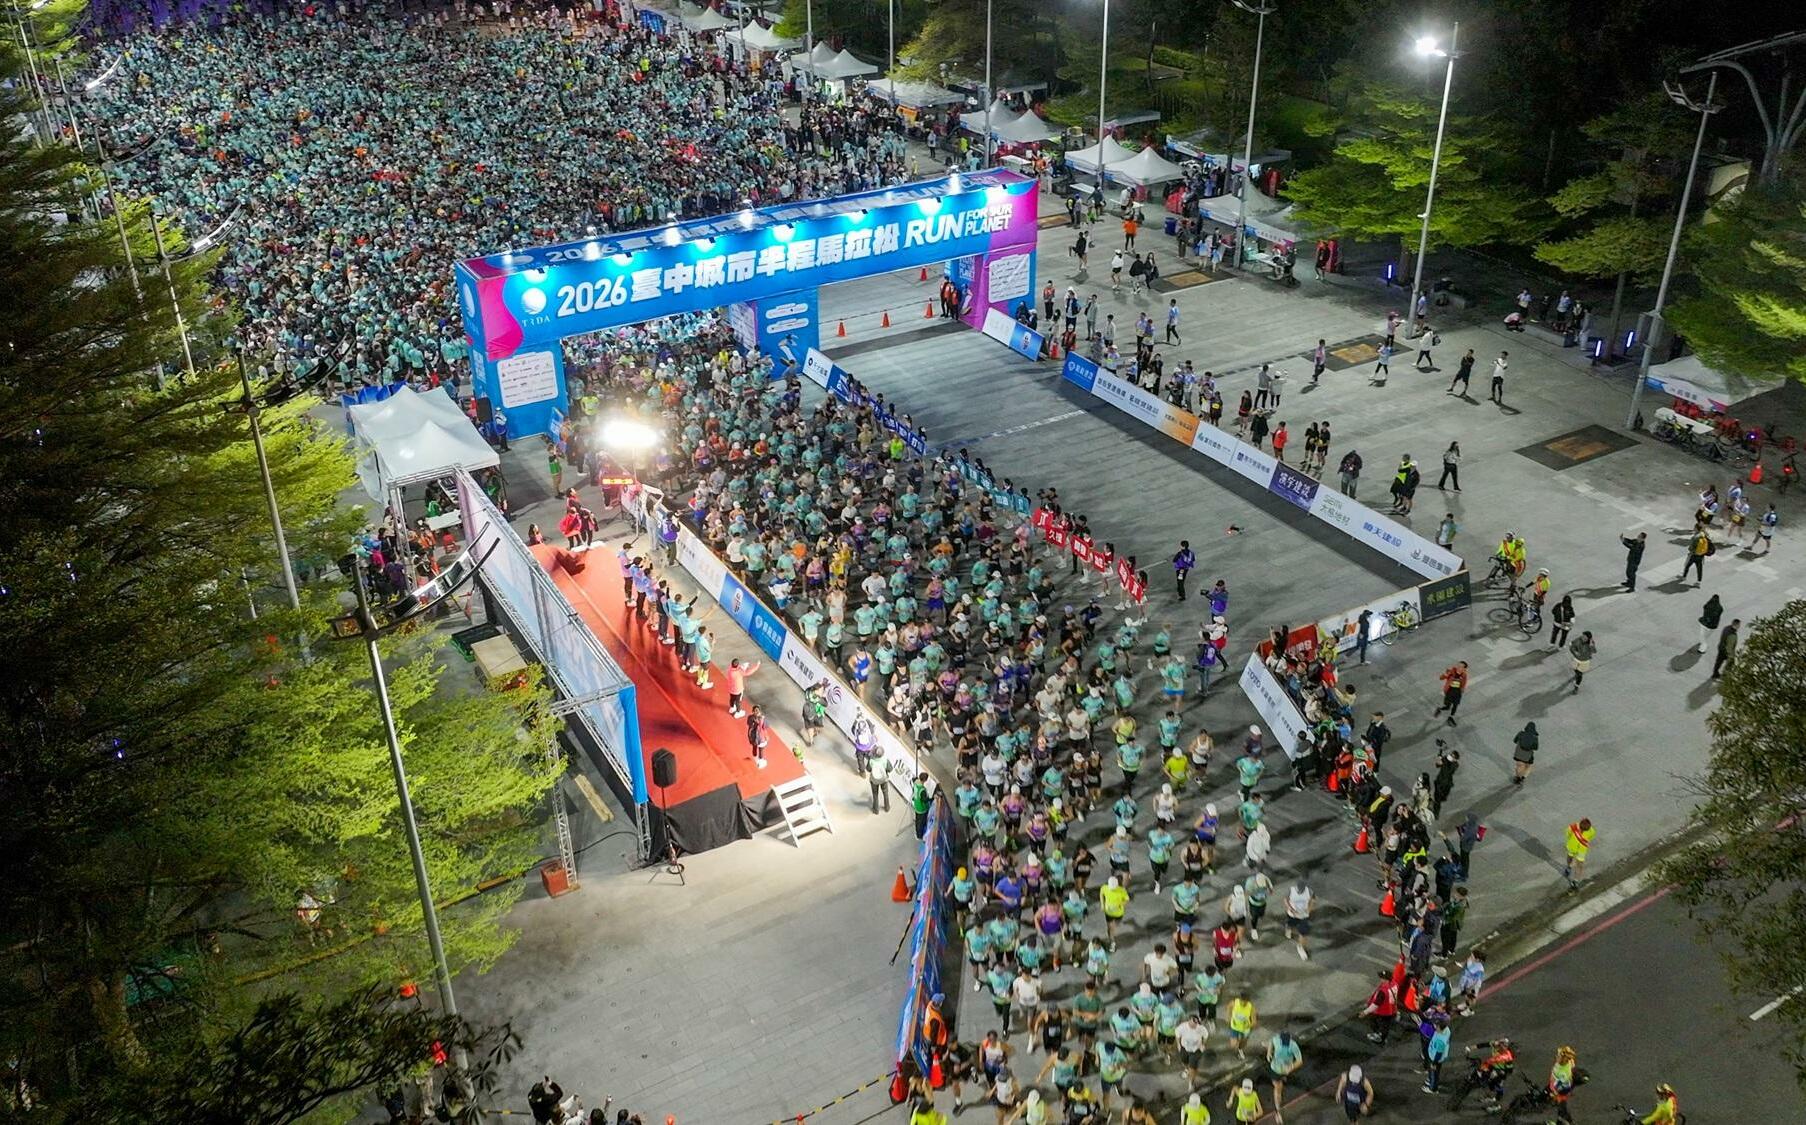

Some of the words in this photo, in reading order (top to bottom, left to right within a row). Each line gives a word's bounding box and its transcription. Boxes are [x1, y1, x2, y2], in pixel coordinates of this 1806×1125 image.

[966, 207, 988, 221] FOR
[964, 215, 1012, 237] PLANET
[556, 275, 628, 318] 2026
[902, 211, 967, 249] RUN
